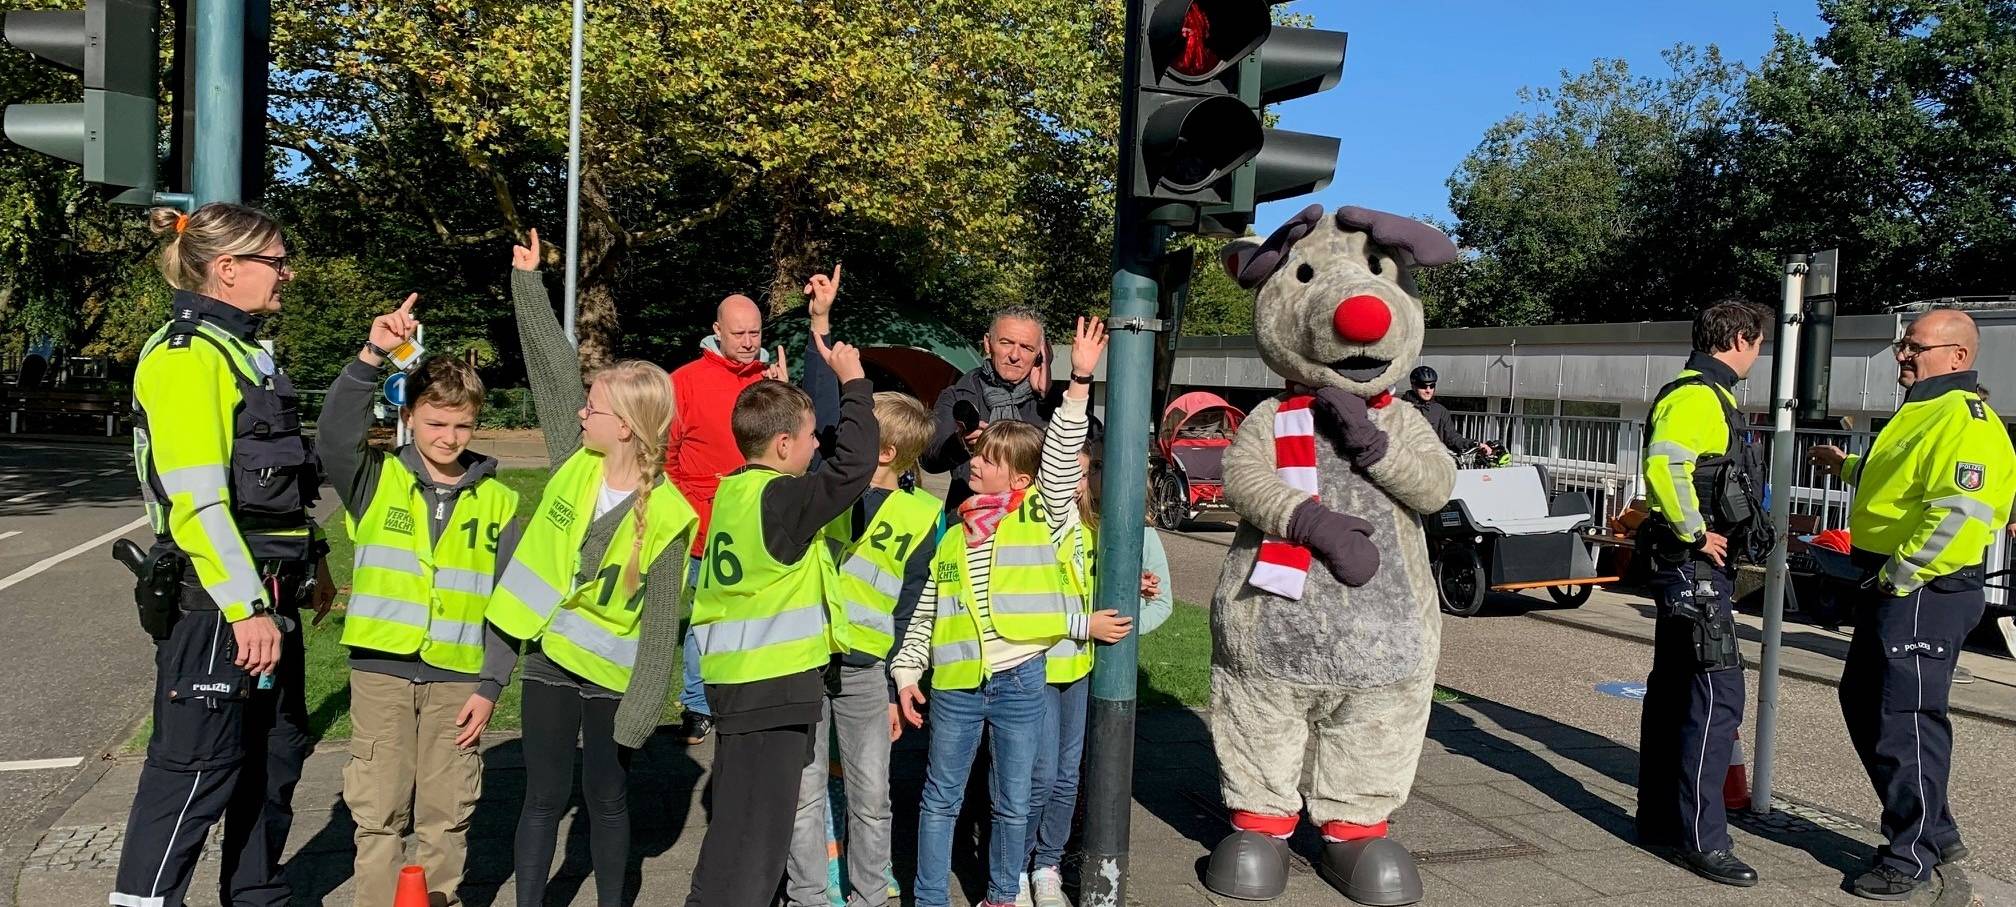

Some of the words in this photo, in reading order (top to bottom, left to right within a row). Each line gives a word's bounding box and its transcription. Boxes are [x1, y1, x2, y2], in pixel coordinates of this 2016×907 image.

[392, 377, 405, 402] 1
[387, 510, 415, 525] VERKE
[1019, 493, 1047, 523] 18
[460, 517, 500, 554] 19
[869, 520, 913, 562] 21
[1904, 641, 1931, 652] POLIZEI
[192, 682, 231, 694] POLIZEI
